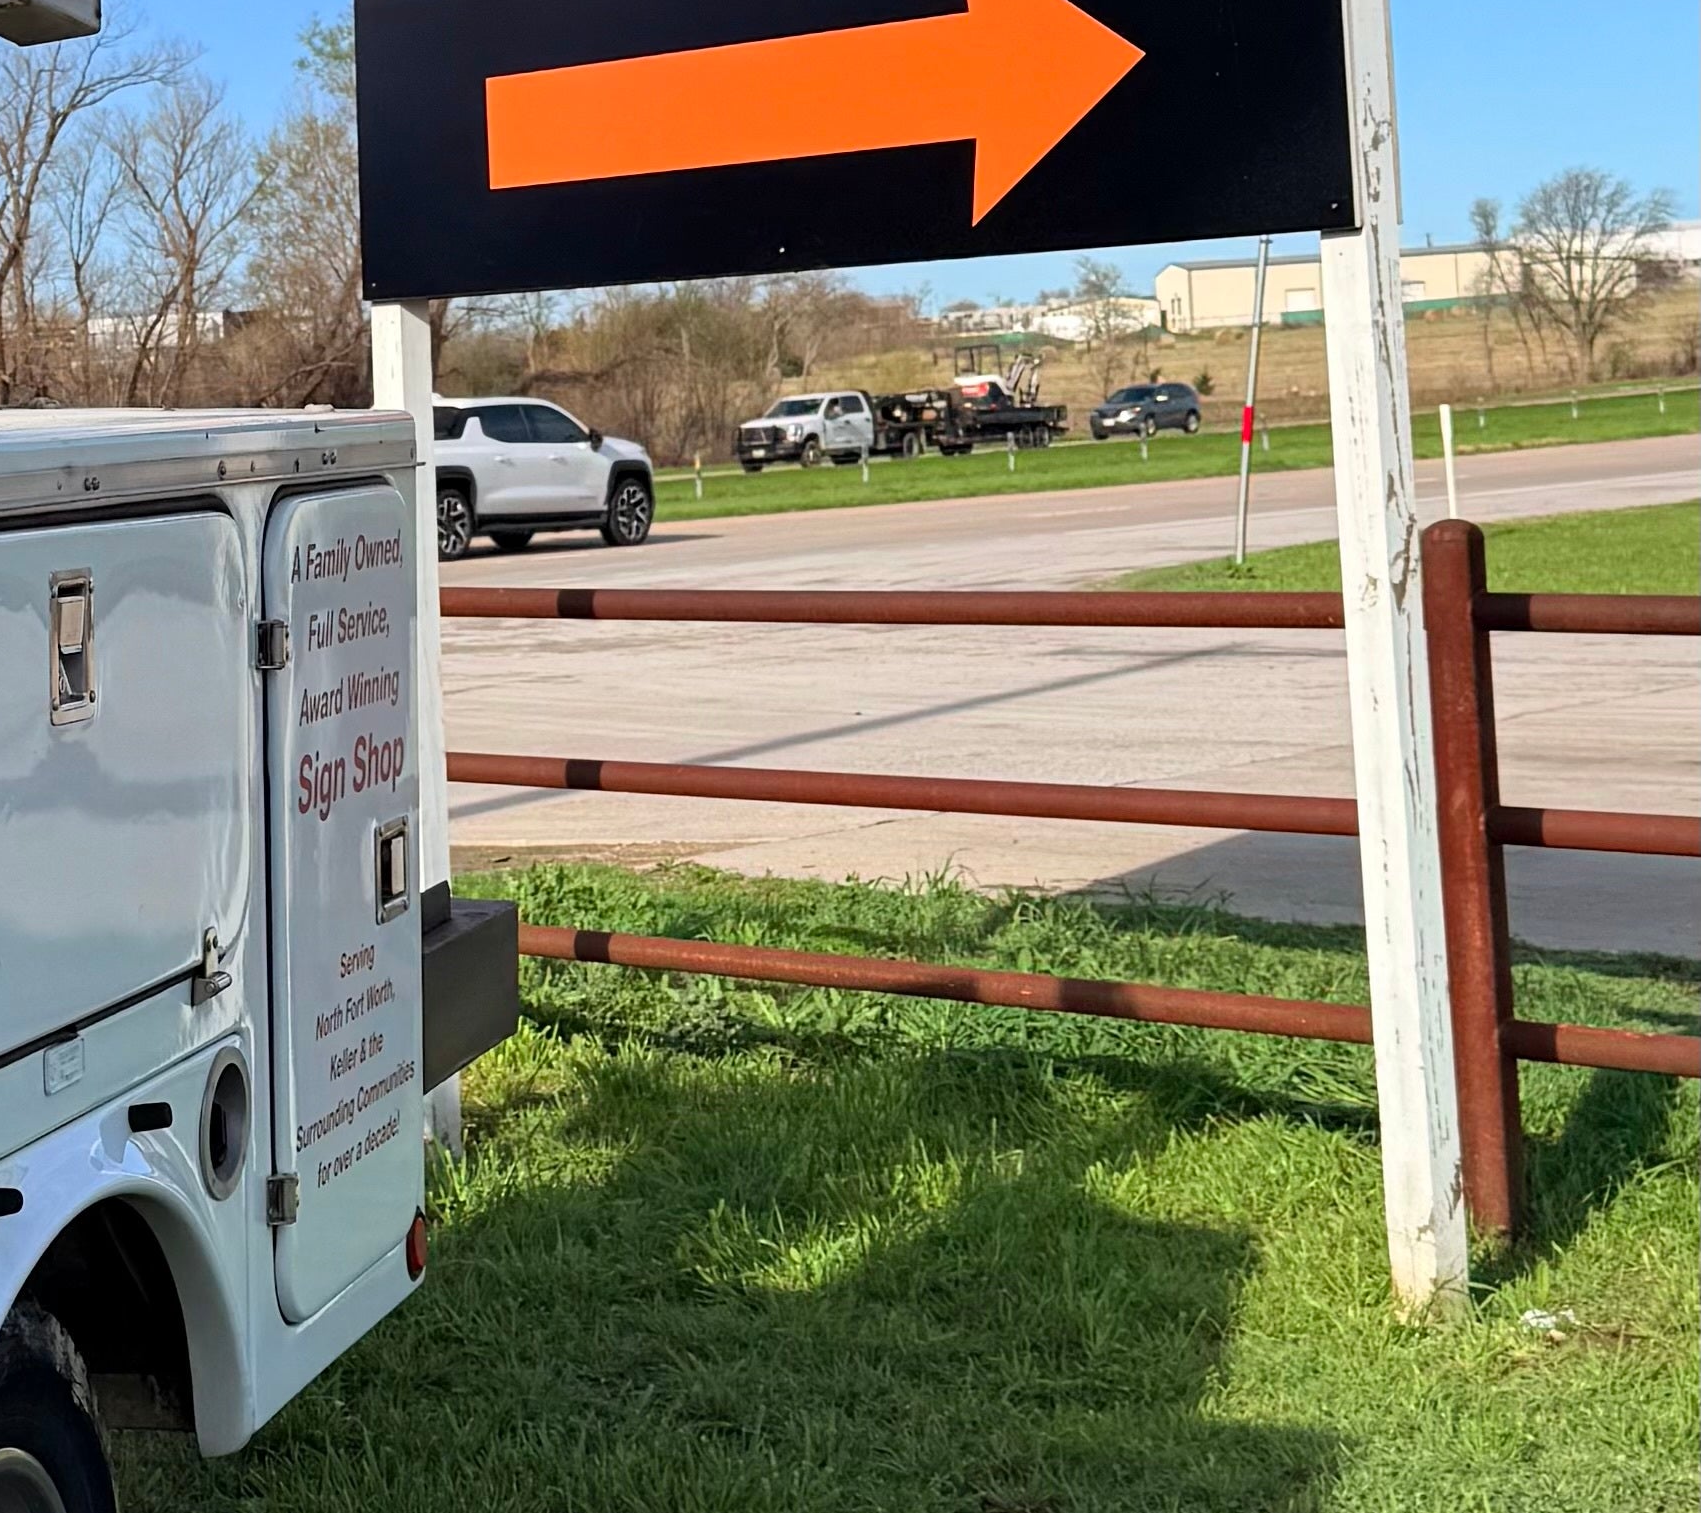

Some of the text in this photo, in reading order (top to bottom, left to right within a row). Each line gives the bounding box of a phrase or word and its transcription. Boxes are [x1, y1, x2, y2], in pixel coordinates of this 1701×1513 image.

[291, 528, 403, 584] A Family Owned,
[308, 601, 390, 652] Full Service,
[299, 666, 400, 727] Award Winning
[298, 732, 405, 822] Sign Shop
[340, 943, 375, 979] Serving
[316, 977, 396, 1041] North Fort Worth,
[330, 1031, 384, 1082] Keller & the
[296, 1059, 415, 1153] Surrounding Communities
[318, 1161, 332, 1189] for
[333, 1142, 355, 1177] over
[356, 1141, 363, 1161] a
